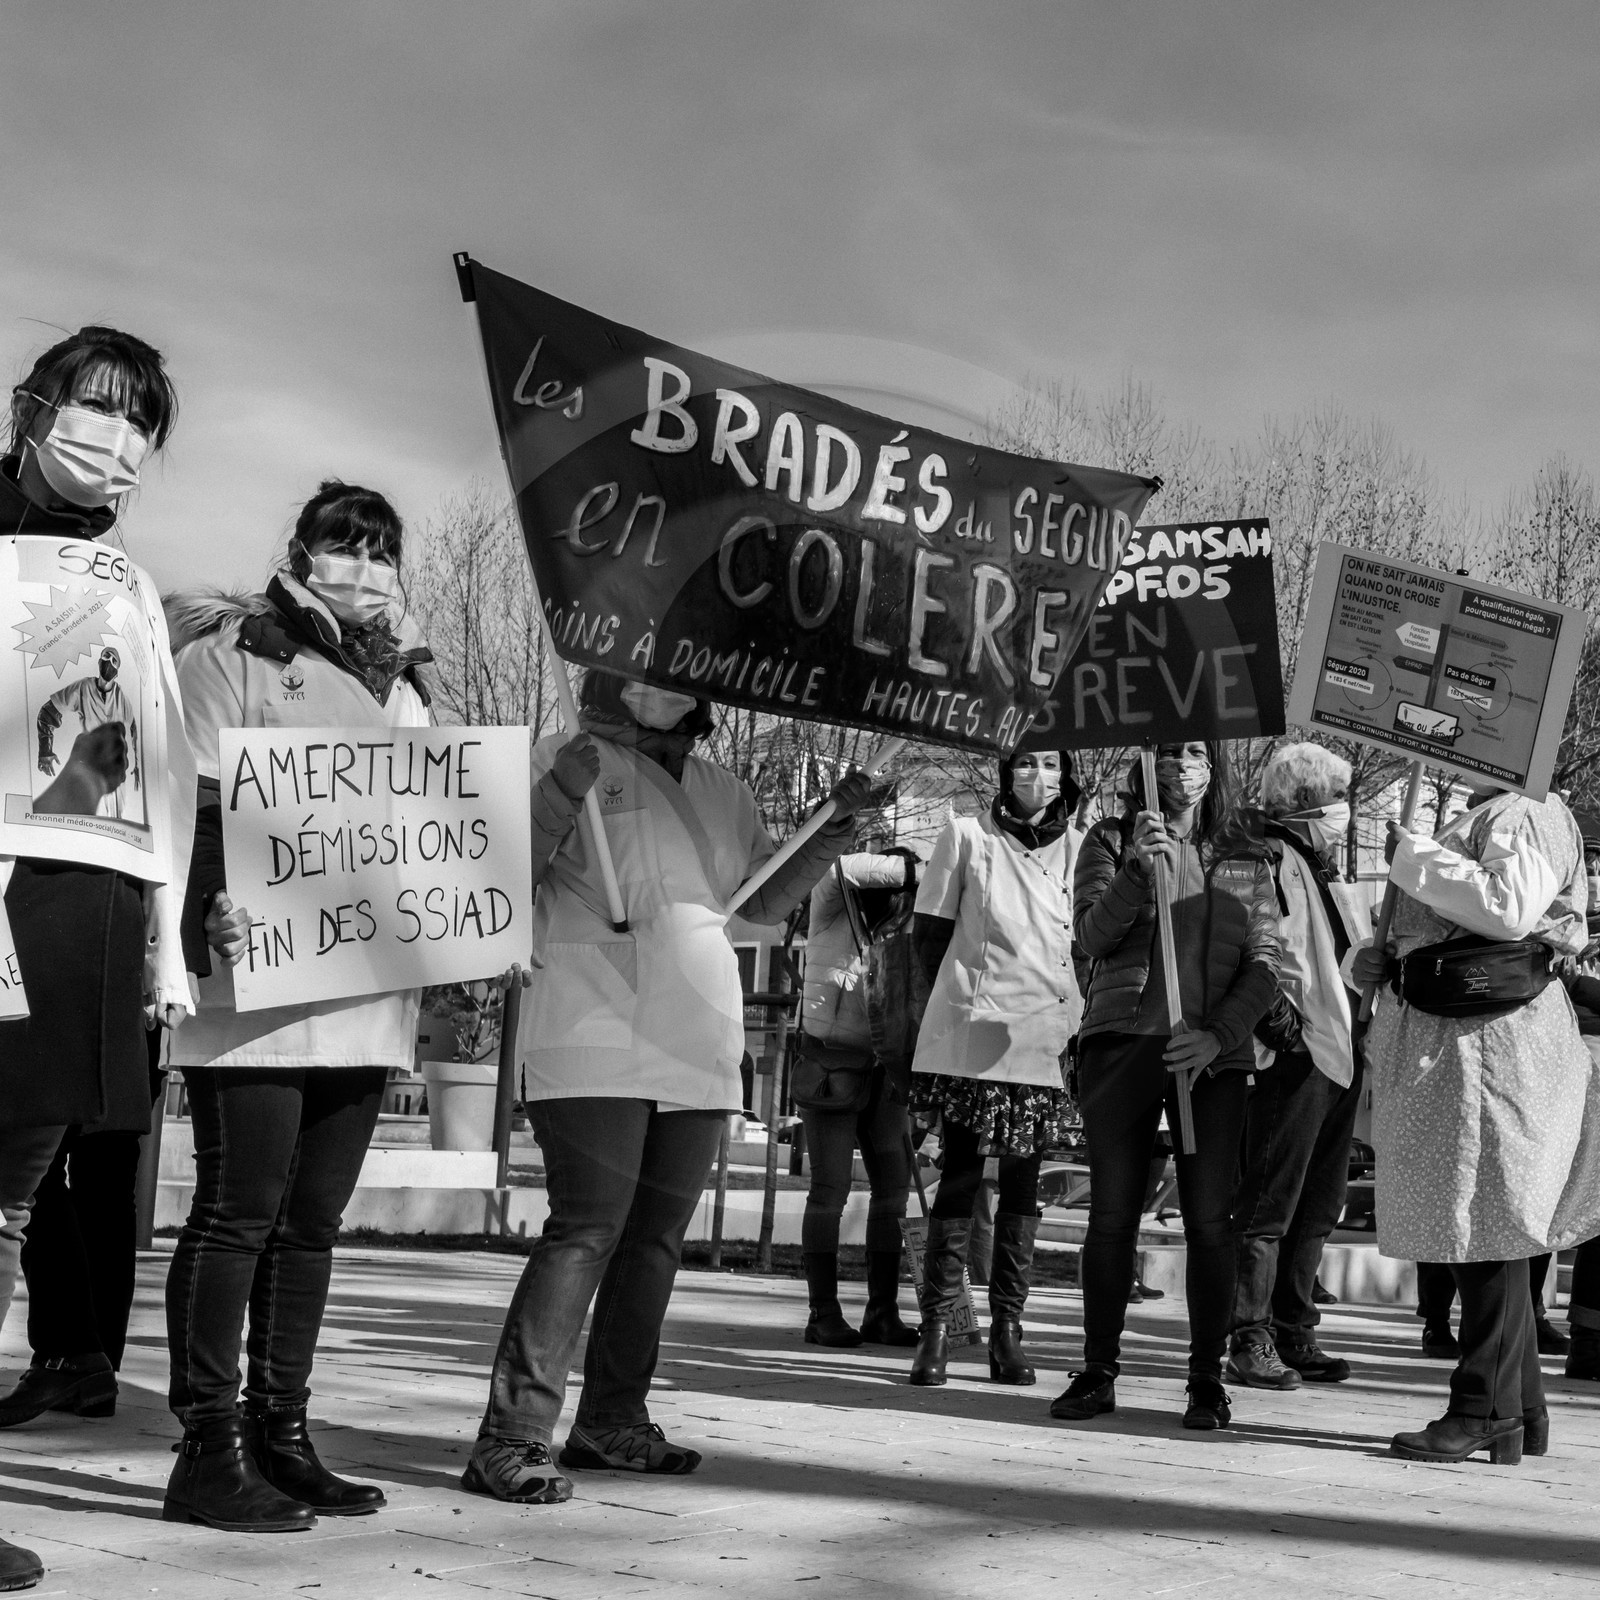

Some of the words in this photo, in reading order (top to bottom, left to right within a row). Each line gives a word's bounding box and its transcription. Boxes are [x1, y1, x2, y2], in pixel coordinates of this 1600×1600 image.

[630, 356, 954, 533] BRADÉS
[955, 499, 996, 543] du
[1013, 486, 1132, 575] SEGUR
[551, 481, 670, 567] en
[1121, 526, 1272, 567] SAMSAH
[1097, 564, 1233, 608] PF.05
[1344, 573, 1384, 593] QUAND
[1385, 584, 1402, 598] ON
[1404, 589, 1441, 608] CROISE
[1347, 558, 1365, 571] ON
[1366, 563, 1382, 577] NE
[1382, 567, 1406, 583] SAIT
[1406, 574, 1446, 594] JAMAIS
[38, 632, 62, 653] Grande
[61, 613, 88, 637] Braderie
[88, 600, 104, 615] 2021
[45, 625, 53, 633] A
[51, 607, 77, 628] SAISIR
[1465, 606, 1498, 620] pourquoi
[1498, 615, 1522, 627] salaire
[1522, 621, 1545, 634] inégal
[1545, 627, 1551, 635] ?
[1480, 599, 1525, 618] qualification
[631, 618, 657, 670] À
[1087, 606, 1169, 658] EN
[1327, 659, 1348, 672] Ségur
[1348, 665, 1367, 677] 2020
[1333, 675, 1343, 683] 183
[1446, 667, 1459, 677] Pas
[1460, 671, 1470, 680] de
[1470, 674, 1491, 686] Ségur
[1416, 723, 1428, 732] OU
[1352, 722, 1393, 740] CONTINUONS
[1420, 743, 1430, 752] NE
[1430, 746, 1449, 758] NOUS
[1448, 751, 1479, 769] LAISSONS
[1479, 762, 1492, 773] PAS
[25, 812, 65, 824] Personnel
[316, 899, 377, 956] DES
[0, 953, 24, 990] E
